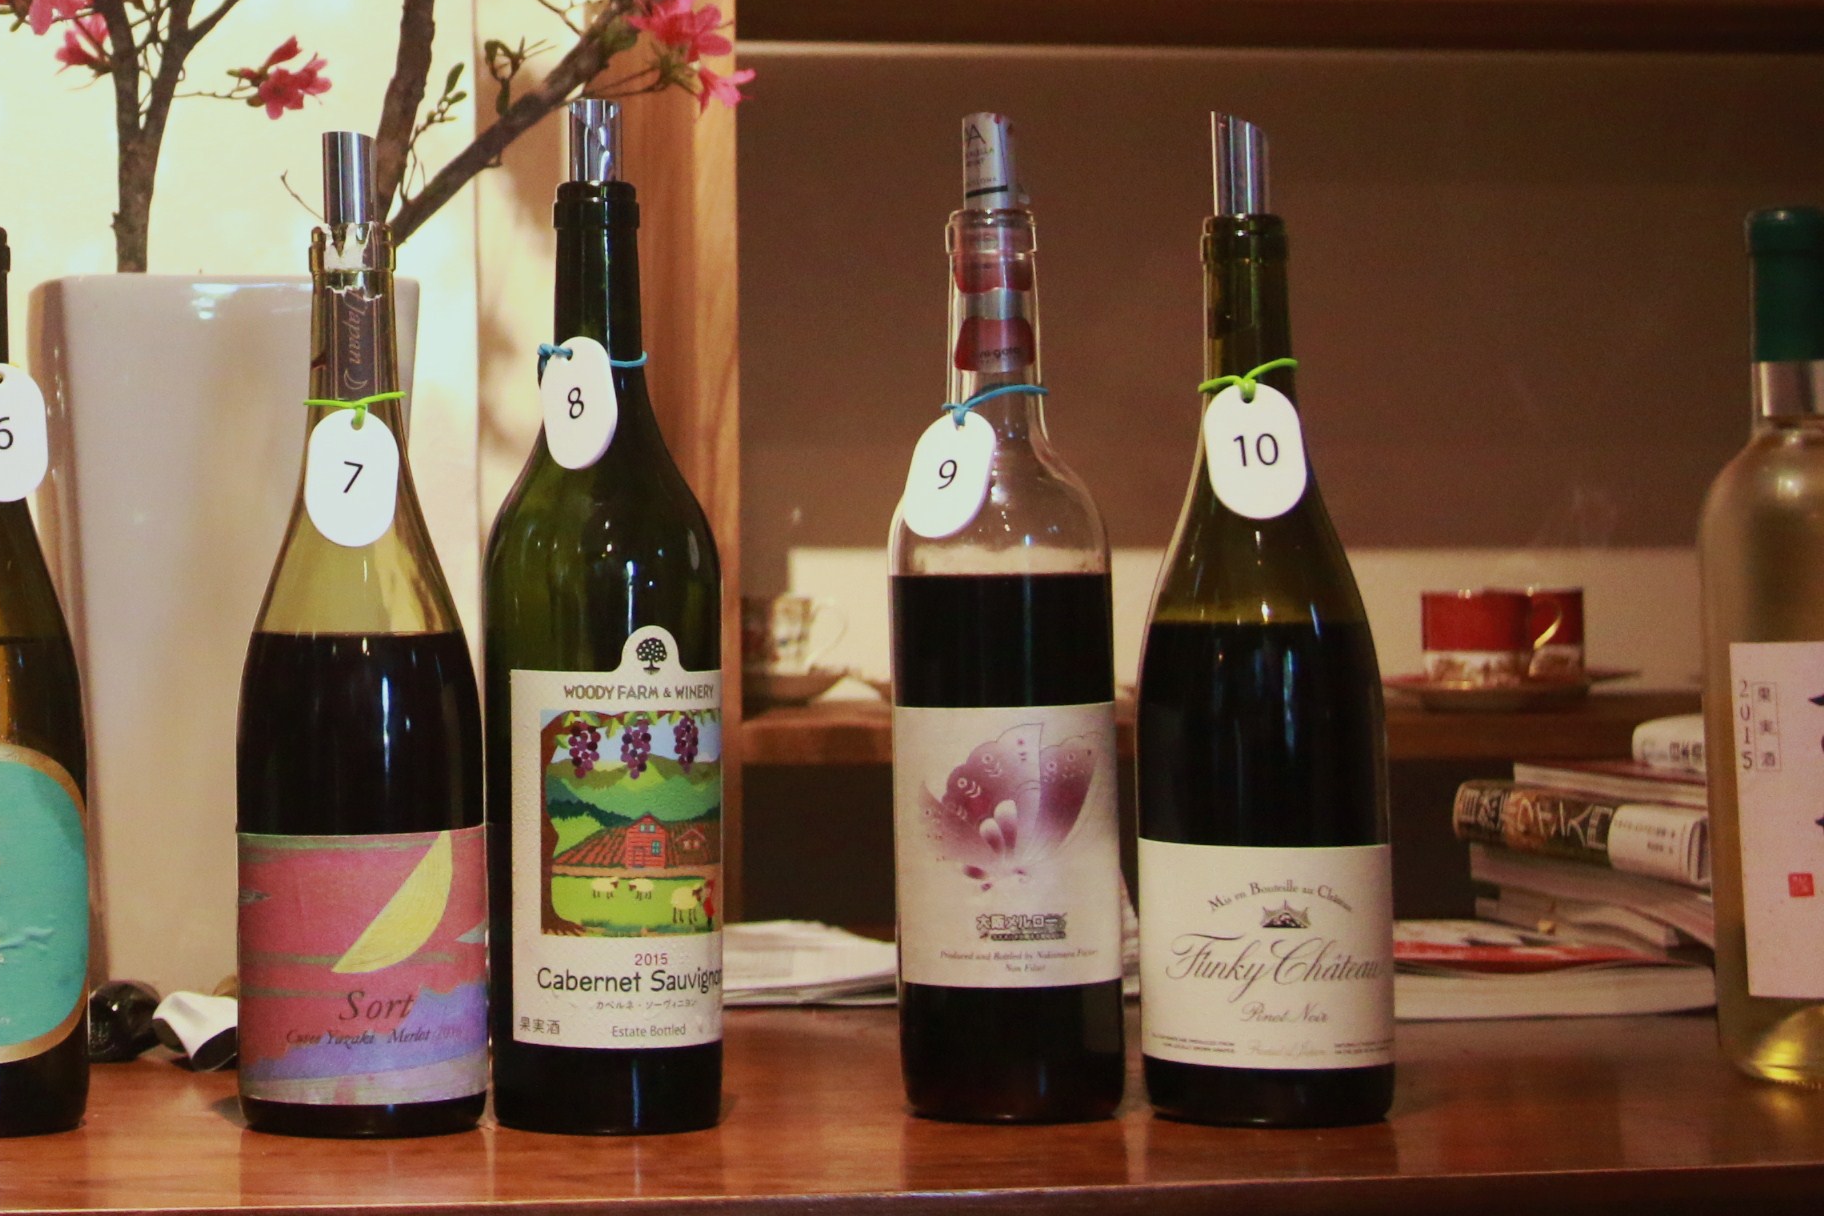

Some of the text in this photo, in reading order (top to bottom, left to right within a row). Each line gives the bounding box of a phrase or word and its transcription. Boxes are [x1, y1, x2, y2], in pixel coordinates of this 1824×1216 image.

[567, 387, 584, 419] 8
[1233, 433, 1280, 468] 10
[342, 461, 364, 494] 7
[938, 459, 958, 490] 9
[563, 684, 714, 700] WOODY FARM & WINERY
[1739, 679, 1753, 770] 2015
[1208, 894, 1232, 912] Mis
[634, 953, 668, 967] 2015
[1165, 933, 1266, 1004] Funky
[537, 967, 642, 993] Cabernet
[338, 989, 415, 1022] Sort
[1240, 1000, 1289, 1022] Pinot
[386, 1027, 431, 1044] Merlot
[519, 1015, 561, 1035] 果実酒
[611, 1023, 687, 1038] Estate Bottled
